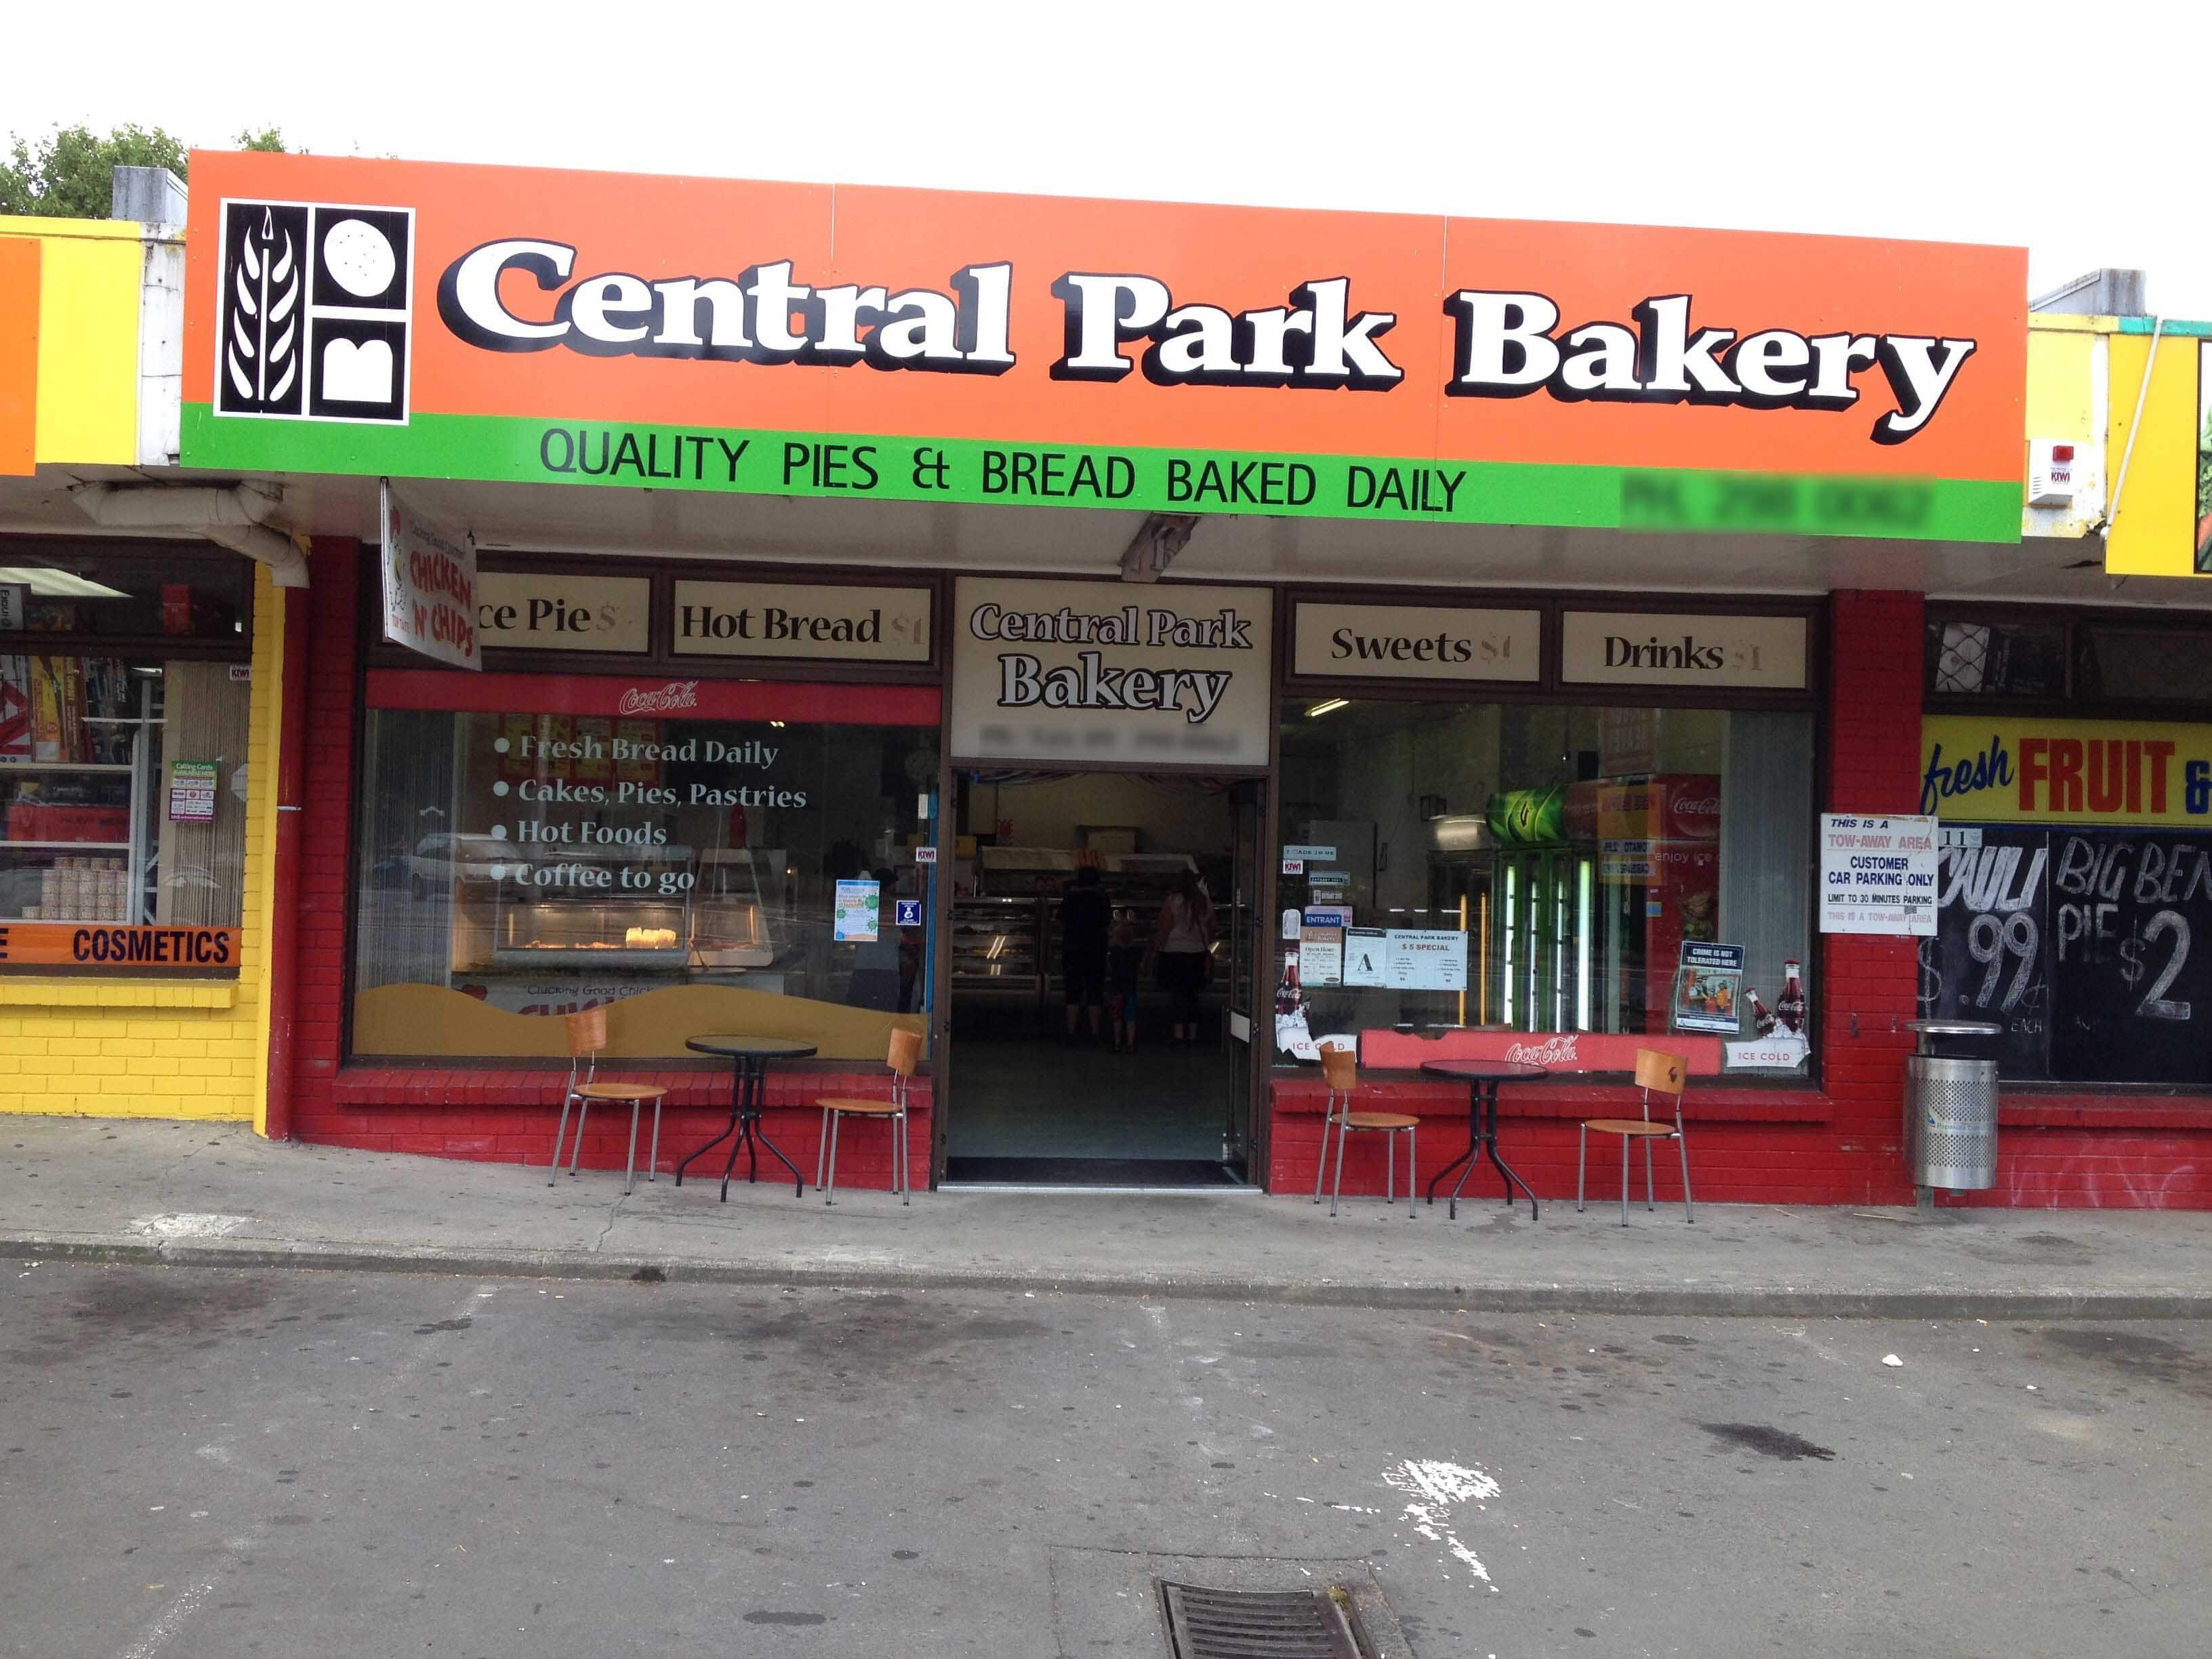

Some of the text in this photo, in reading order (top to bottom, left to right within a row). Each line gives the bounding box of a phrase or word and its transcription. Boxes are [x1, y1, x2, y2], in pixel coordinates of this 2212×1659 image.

[438, 239, 1976, 444] Central Park Bakery
[541, 428, 748, 481] QUALITY
[783, 443, 879, 490] PIES
[983, 451, 1135, 498] BREAD
[1168, 459, 1316, 506] BAKED
[1347, 466, 1466, 513] DAILY
[2051, 472, 2070, 483] KIWI
[409, 550, 472, 610] CHICKEN
[527, 598, 592, 633] Pie
[680, 605, 756, 639] Hot
[762, 607, 882, 643] Bread
[969, 603, 1254, 651] Central Park
[430, 602, 474, 657] CHIPS
[1330, 627, 1472, 665] Sweets
[1603, 635, 1724, 670] Drinks
[231, 668, 250, 678] KIWI
[619, 680, 699, 715] Coca-Cola
[998, 651, 1233, 724] Bakery
[520, 735, 779, 769] Fresh Bread Daily
[1919, 734, 2212, 815] fresh FRUIT &
[518, 779, 808, 808] Cakes, Pies, Pastries
[518, 821, 668, 845] Hot Foods
[1831, 819, 1889, 829] THIS IS A
[918, 851, 935, 859] KIWI
[1828, 834, 1931, 850] TOW-AWAY AREA
[1284, 863, 1301, 872] KIWI
[1655, 851, 1689, 863] enjoy
[1695, 852, 1712, 861] ice
[1850, 856, 1908, 870] CUSTOMER
[2055, 836, 2133, 901] BIG
[515, 863, 695, 895] Coffee to go
[1828, 872, 1934, 886] CAR PARKING ONLY
[1828, 893, 1932, 904] LIMIT TO 30 MINUTES PARKING
[1828, 912, 1931, 922] THIS IS A TOW-AWAY AREA
[2057, 902, 2119, 962] PIE
[73, 928, 230, 964] COSMETICS
[1692, 948, 1713, 956] CRIME
[1357, 954, 1373, 971] A
[1687, 956, 1738, 967] TOLERATED HERE
[582, 985, 615, 996] Good
[1292, 1042, 1345, 1050] ICE CD
[1738, 1052, 1790, 1061] ICE COLD
